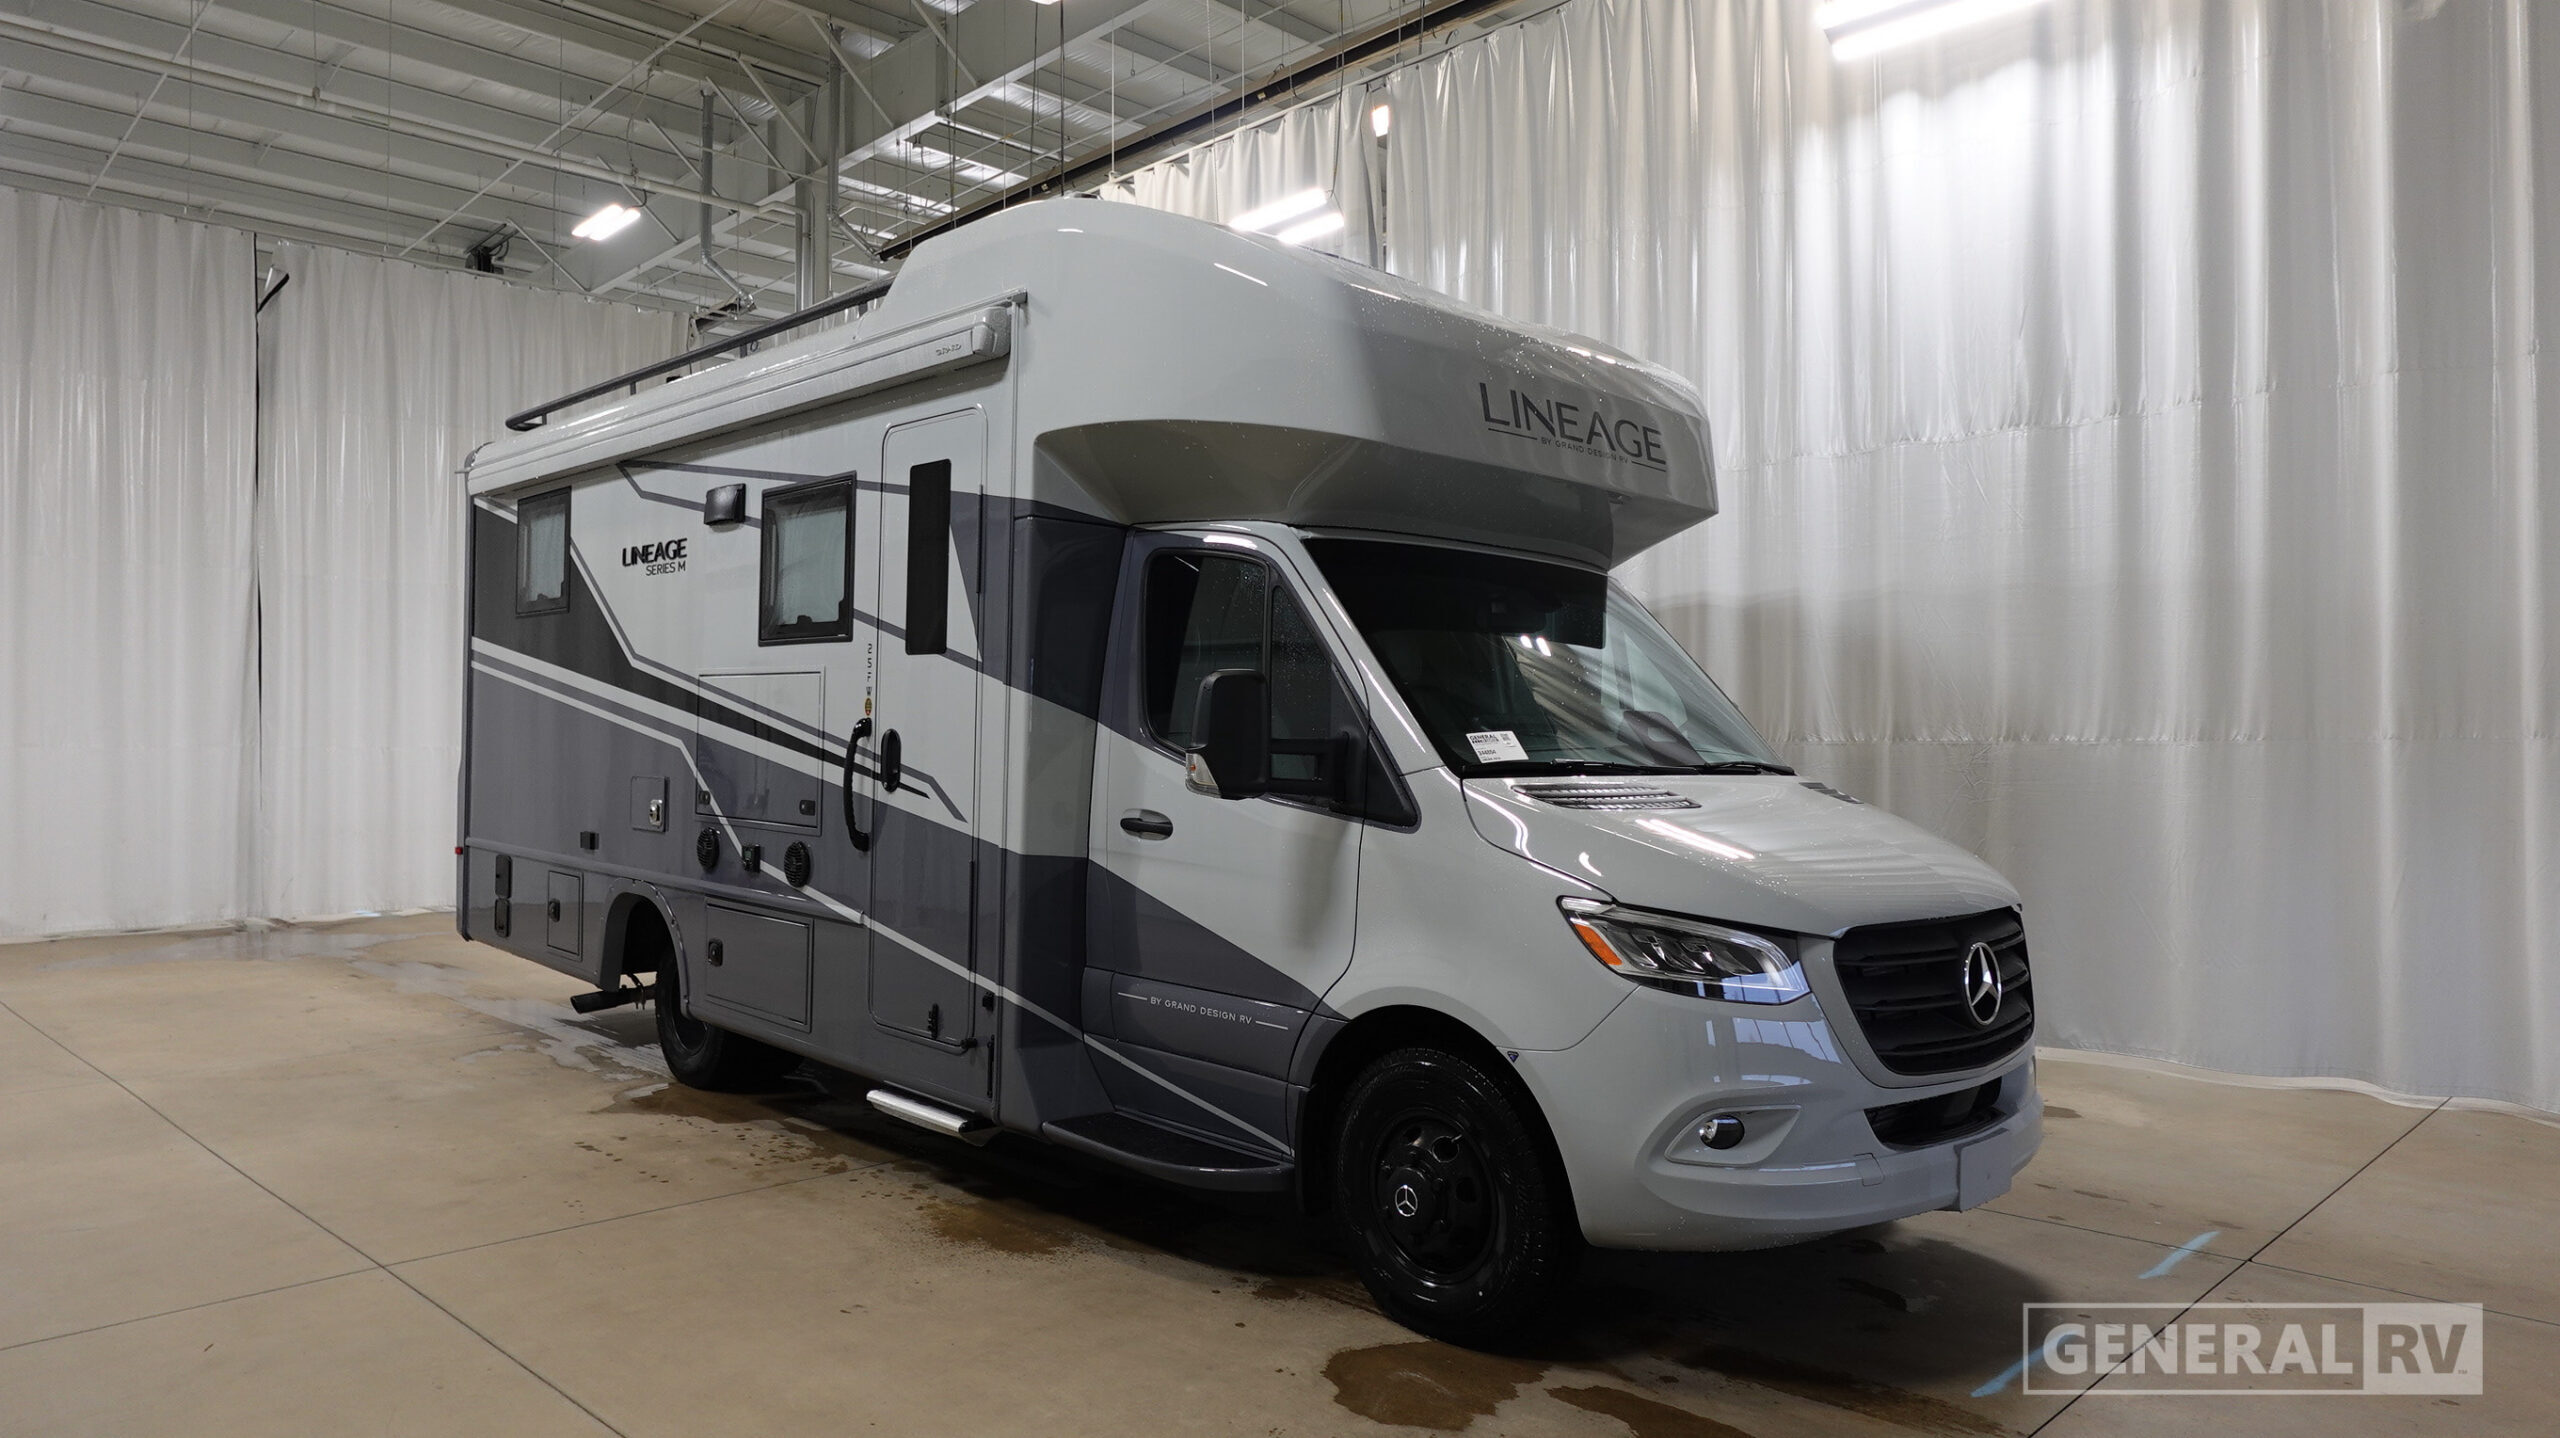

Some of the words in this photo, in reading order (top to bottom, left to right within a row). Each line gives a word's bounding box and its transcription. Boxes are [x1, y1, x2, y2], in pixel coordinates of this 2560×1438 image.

[1479, 382, 1666, 465] LINEAGE
[1588, 447, 1616, 460] DESN
[622, 538, 687, 567] LINEAGE
[646, 562, 676, 576] SERIES
[678, 560, 686, 572] M
[1151, 996, 1161, 1005] BY
[1165, 1000, 1197, 1013] GRAND
[1200, 1007, 1236, 1021] DESIGN
[1240, 1014, 1252, 1024] RV
